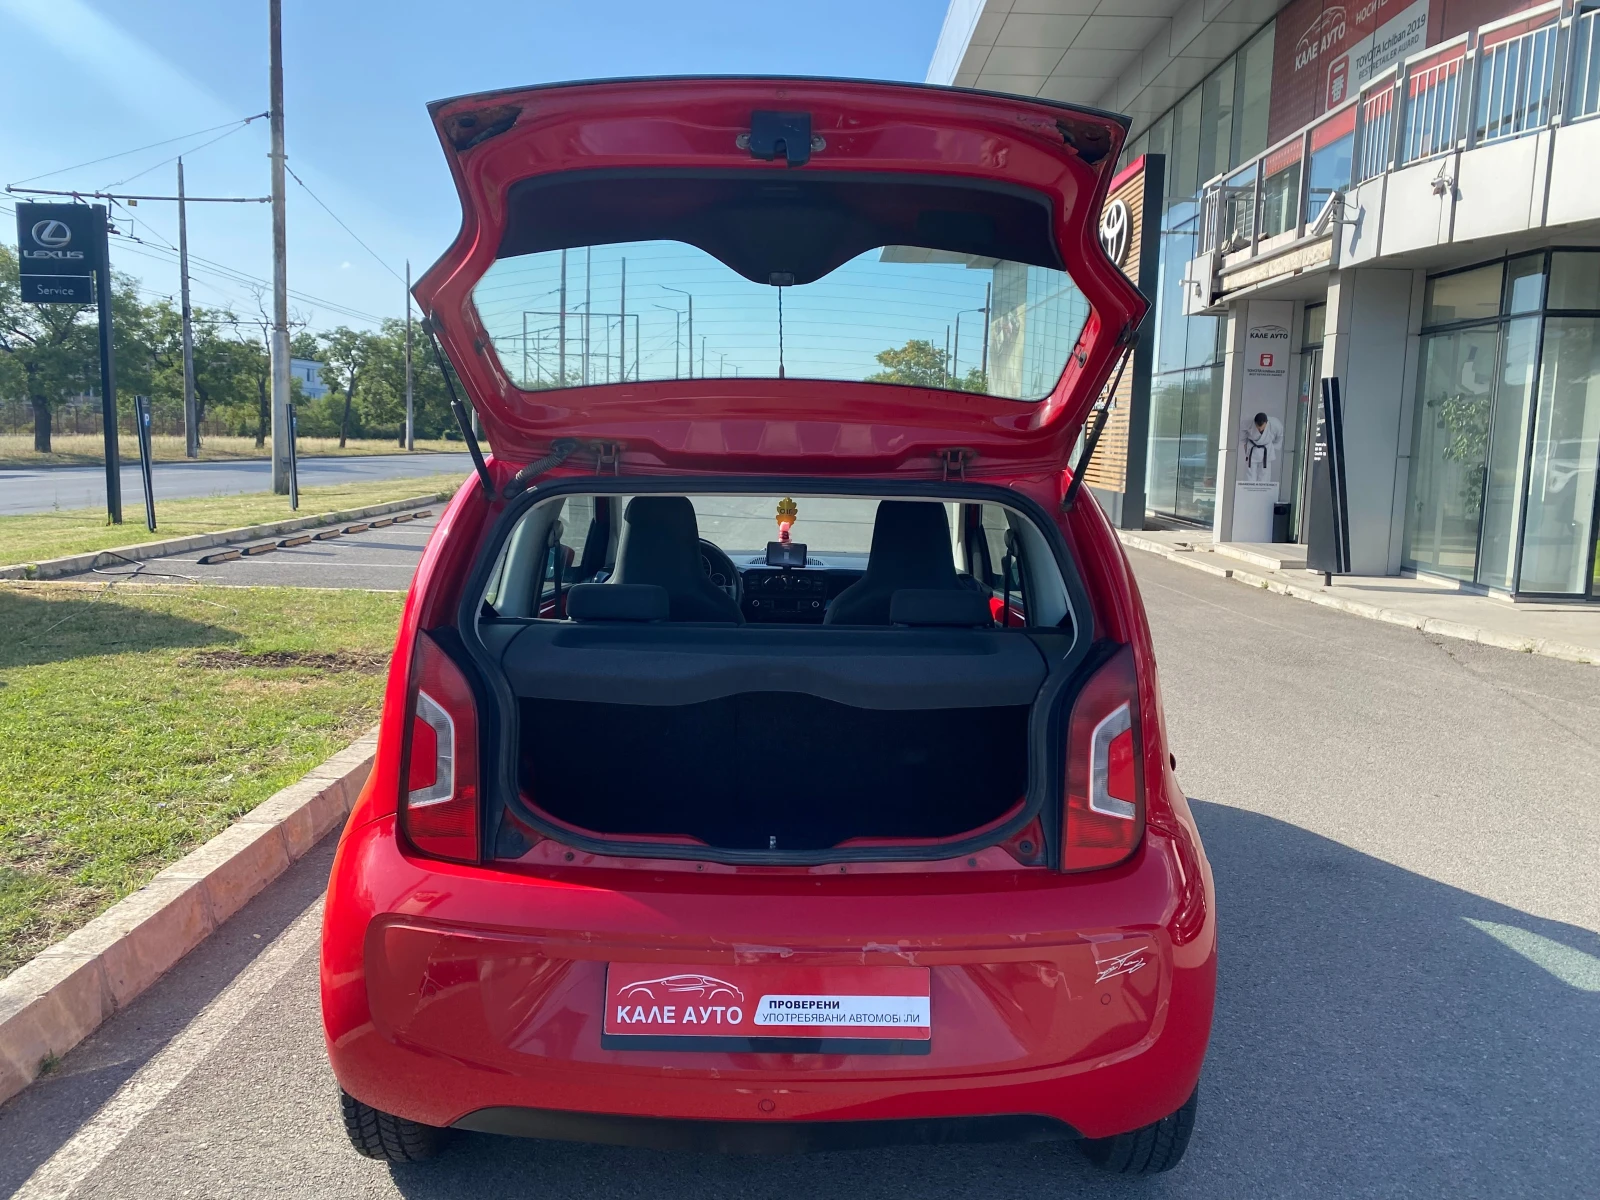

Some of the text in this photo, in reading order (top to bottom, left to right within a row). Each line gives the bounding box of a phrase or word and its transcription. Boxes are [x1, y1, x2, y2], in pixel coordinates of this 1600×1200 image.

[1294, 21, 1347, 72] КАЛЕ АУТО
[1355, 13, 1426, 70] TOYOTA Ichiban 2019
[23, 250, 84, 259] LEXUS
[37, 284, 74, 296] Service
[769, 1000, 840, 1010] ПРОВЕРЕНИ
[616, 1005, 743, 1025] КАЛЕ АУТО
[762, 1013, 846, 1023] УПОТРЕБЯВАНИ
